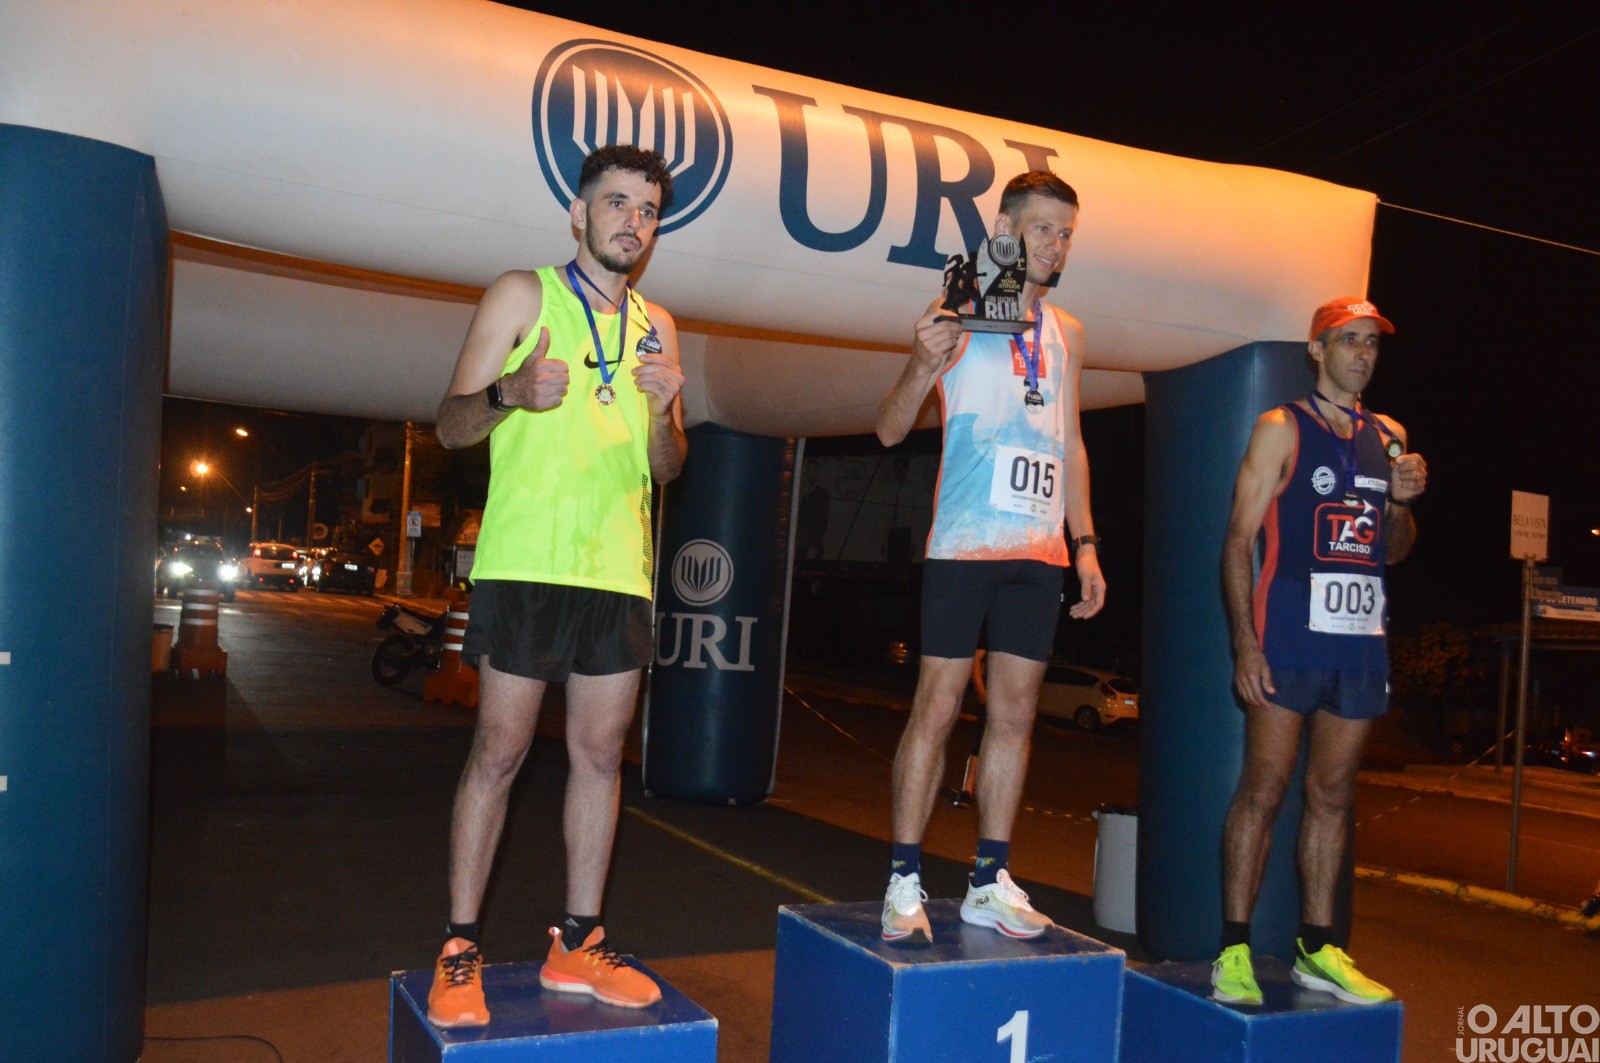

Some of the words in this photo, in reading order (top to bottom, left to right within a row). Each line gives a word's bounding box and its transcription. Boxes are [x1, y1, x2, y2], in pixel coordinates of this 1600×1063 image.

[984, 292, 1023, 321] RUN
[1010, 456, 1055, 498] 015
[1326, 513, 1375, 544] TAG
[1328, 541, 1371, 554] TARCISO
[1324, 581, 1375, 615] 003
[653, 612, 758, 671] URI
[997, 1010, 1029, 1063] 1
